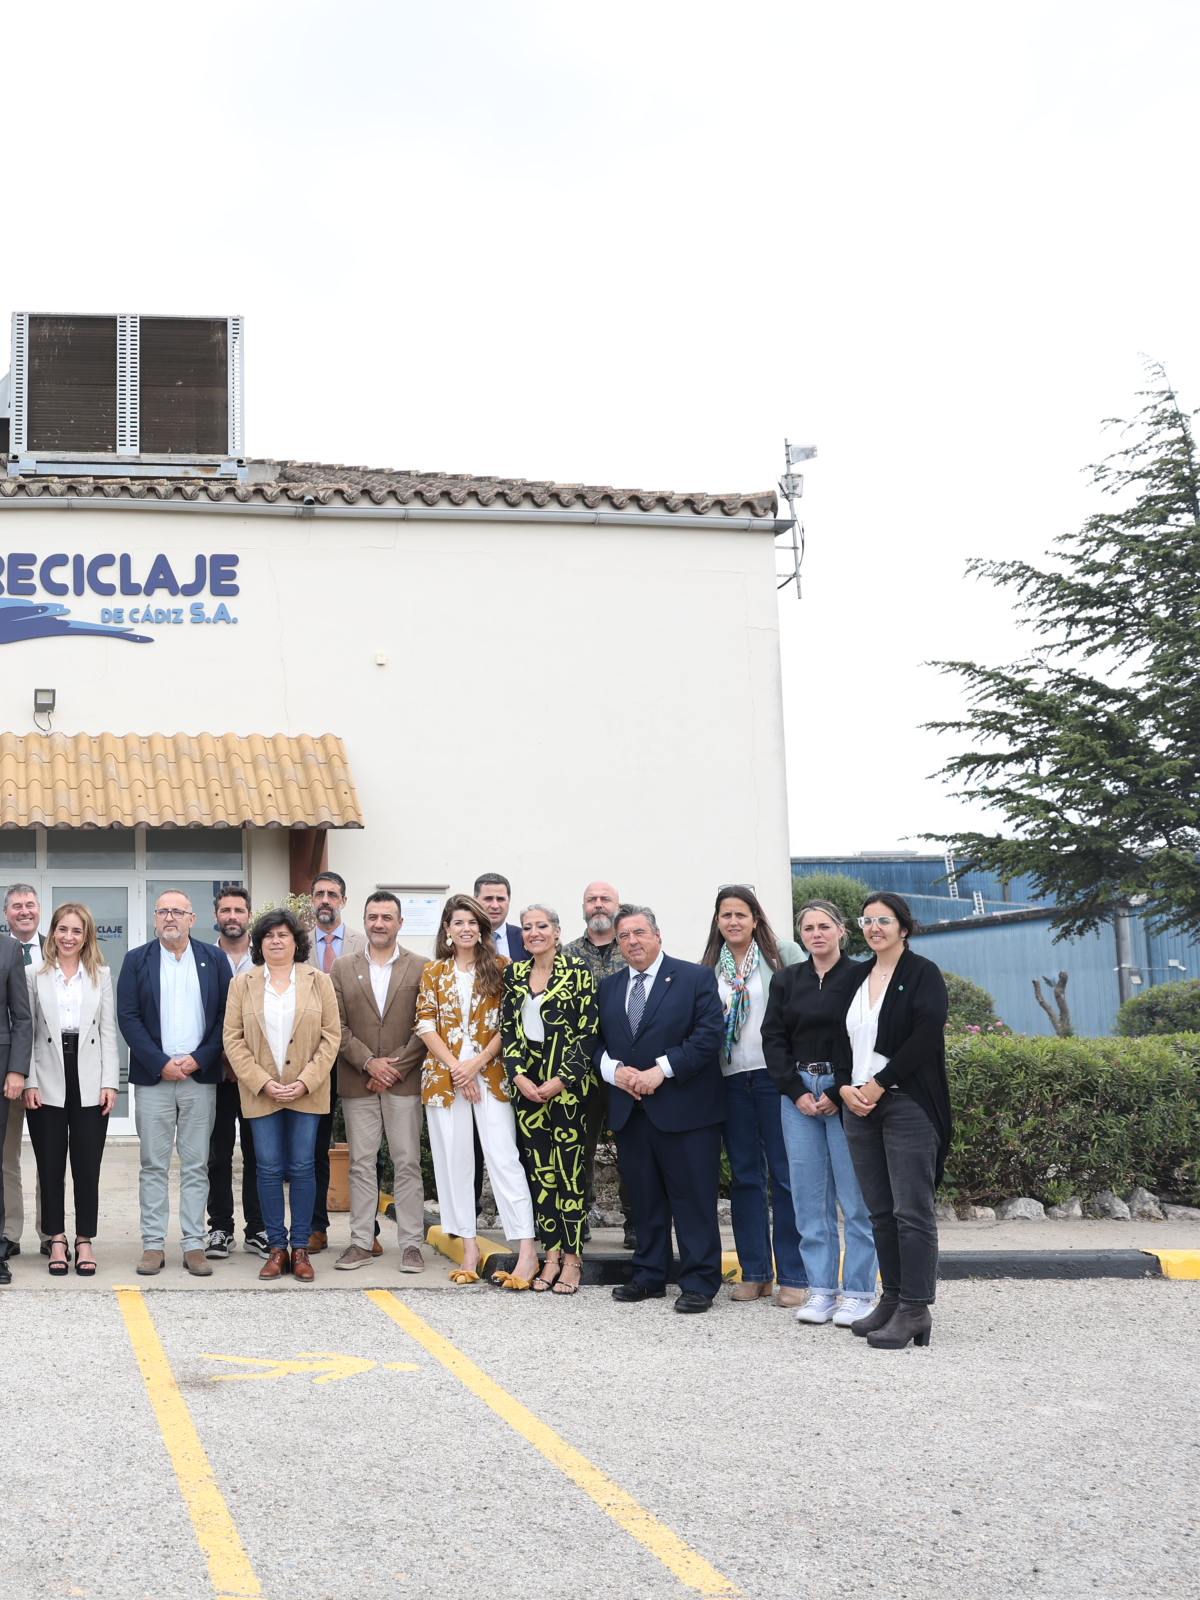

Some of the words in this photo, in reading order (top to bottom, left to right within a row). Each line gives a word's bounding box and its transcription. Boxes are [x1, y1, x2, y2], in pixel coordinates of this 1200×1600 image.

[100, 608, 125, 623] DE
[129, 603, 184, 623] CÁDIZ
[189, 602, 239, 624] S.A.
